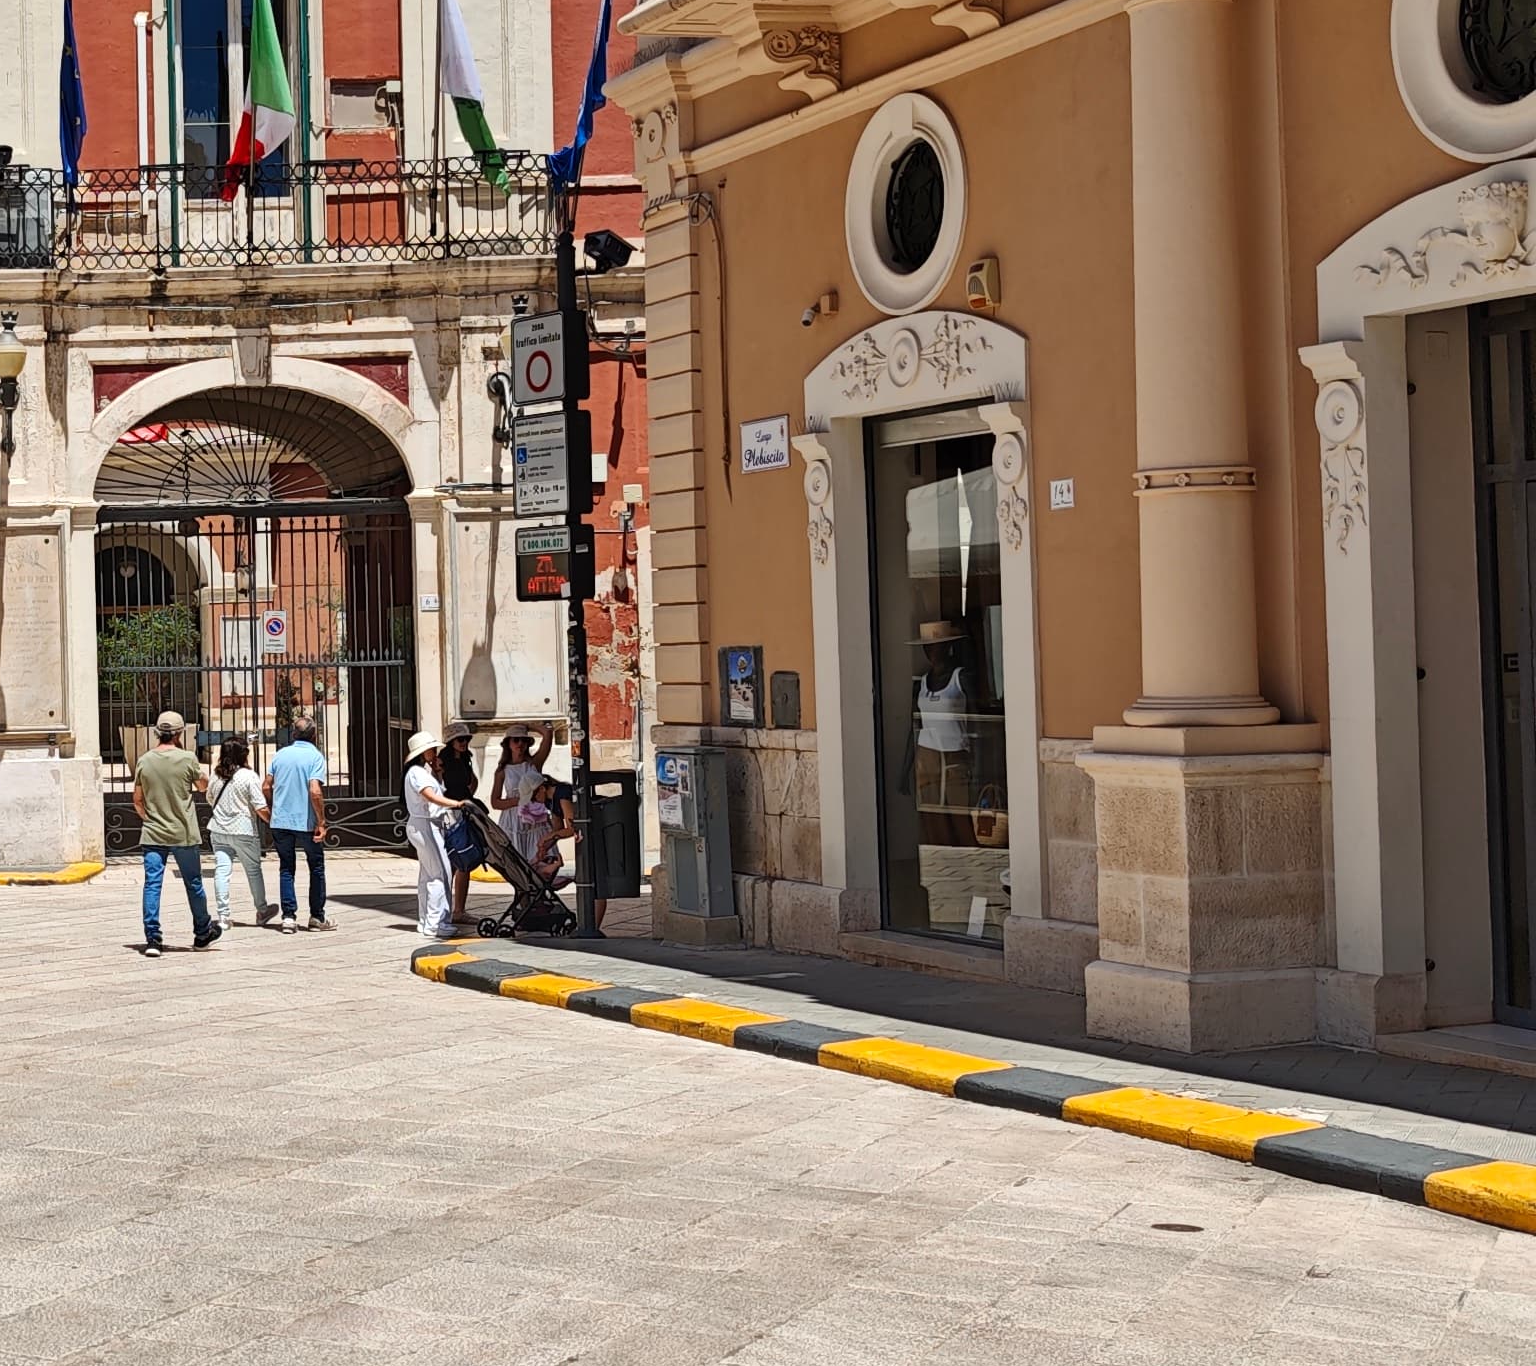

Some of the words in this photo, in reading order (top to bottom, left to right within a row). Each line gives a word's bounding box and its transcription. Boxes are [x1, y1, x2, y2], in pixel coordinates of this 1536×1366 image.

[516, 336, 537, 348] traffico
[539, 332, 561, 345] limitato
[744, 447, 785, 468] Plebiscito
[1054, 484, 1064, 500] 14
[536, 555, 557, 573] ZTL
